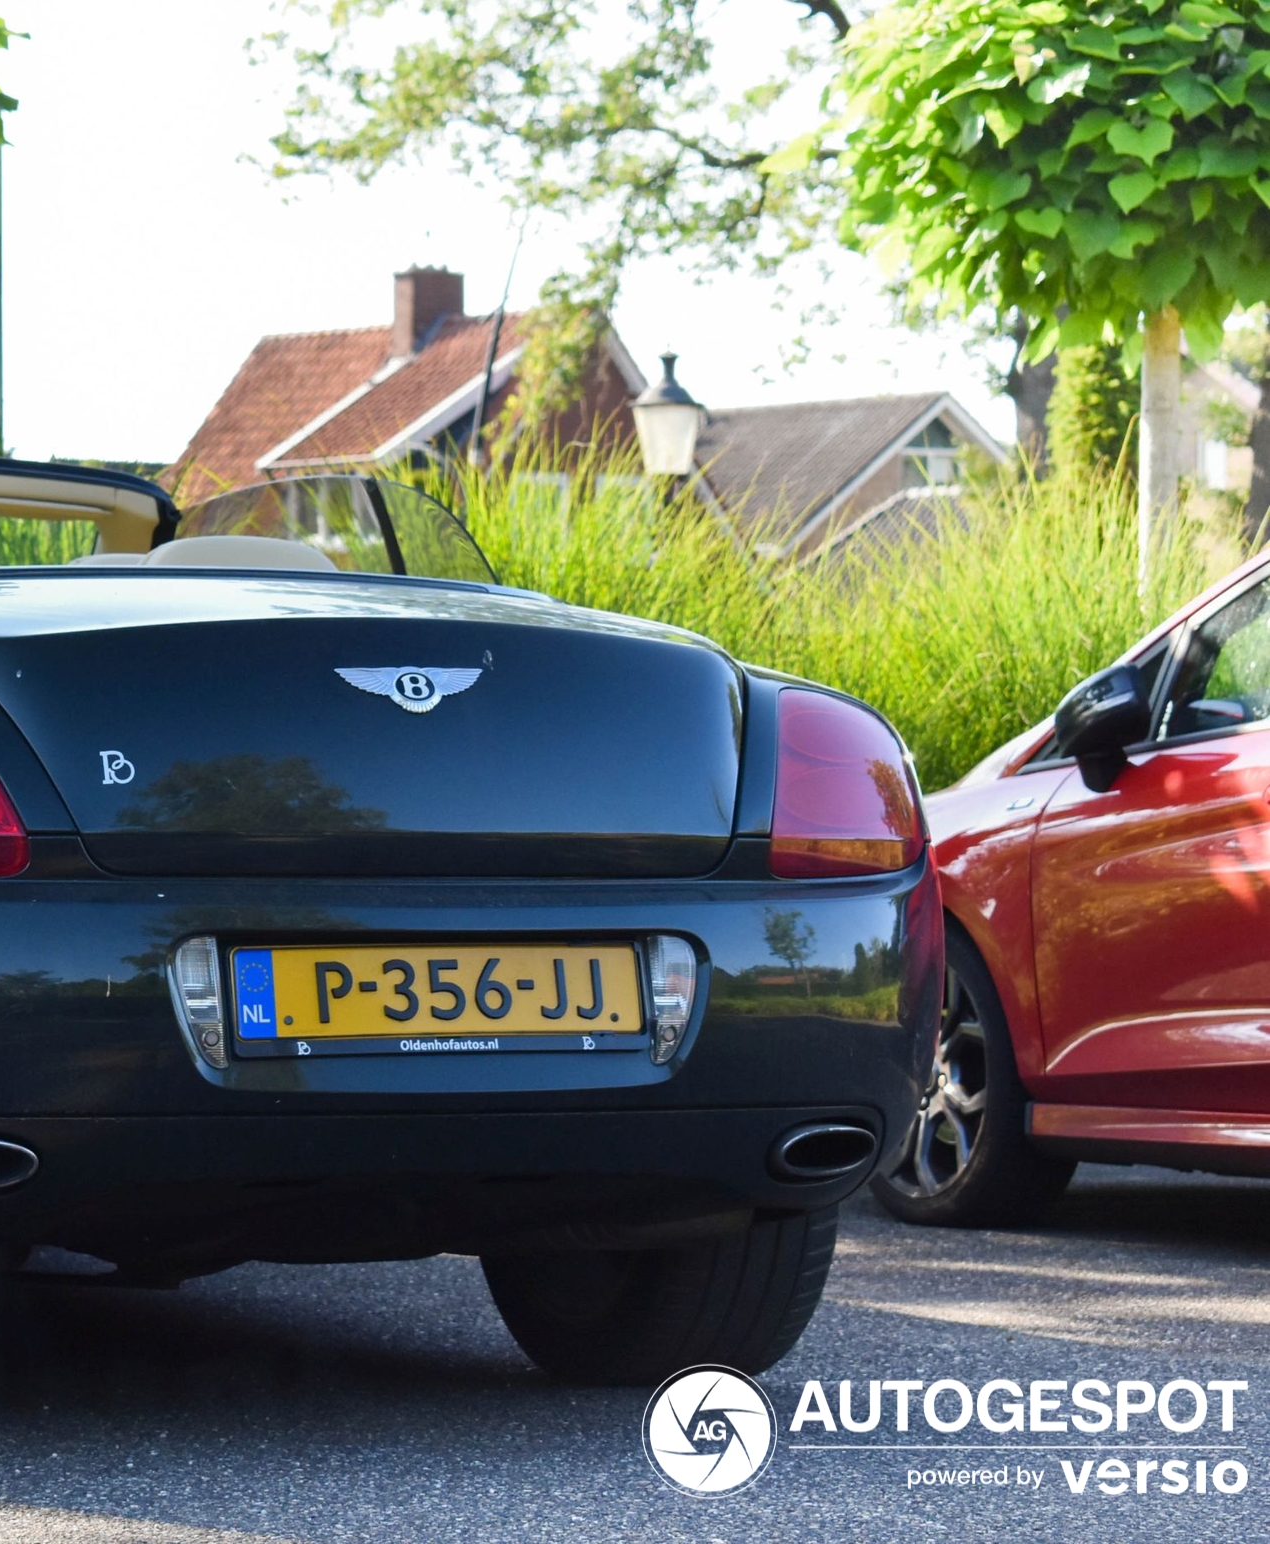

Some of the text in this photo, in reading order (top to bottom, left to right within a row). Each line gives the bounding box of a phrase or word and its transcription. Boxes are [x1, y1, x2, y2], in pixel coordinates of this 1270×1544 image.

[315, 957, 602, 1024] P-356-JJ
[242, 1004, 271, 1024] NL
[400, 1038, 499, 1051] Oldenhofautos.nl
